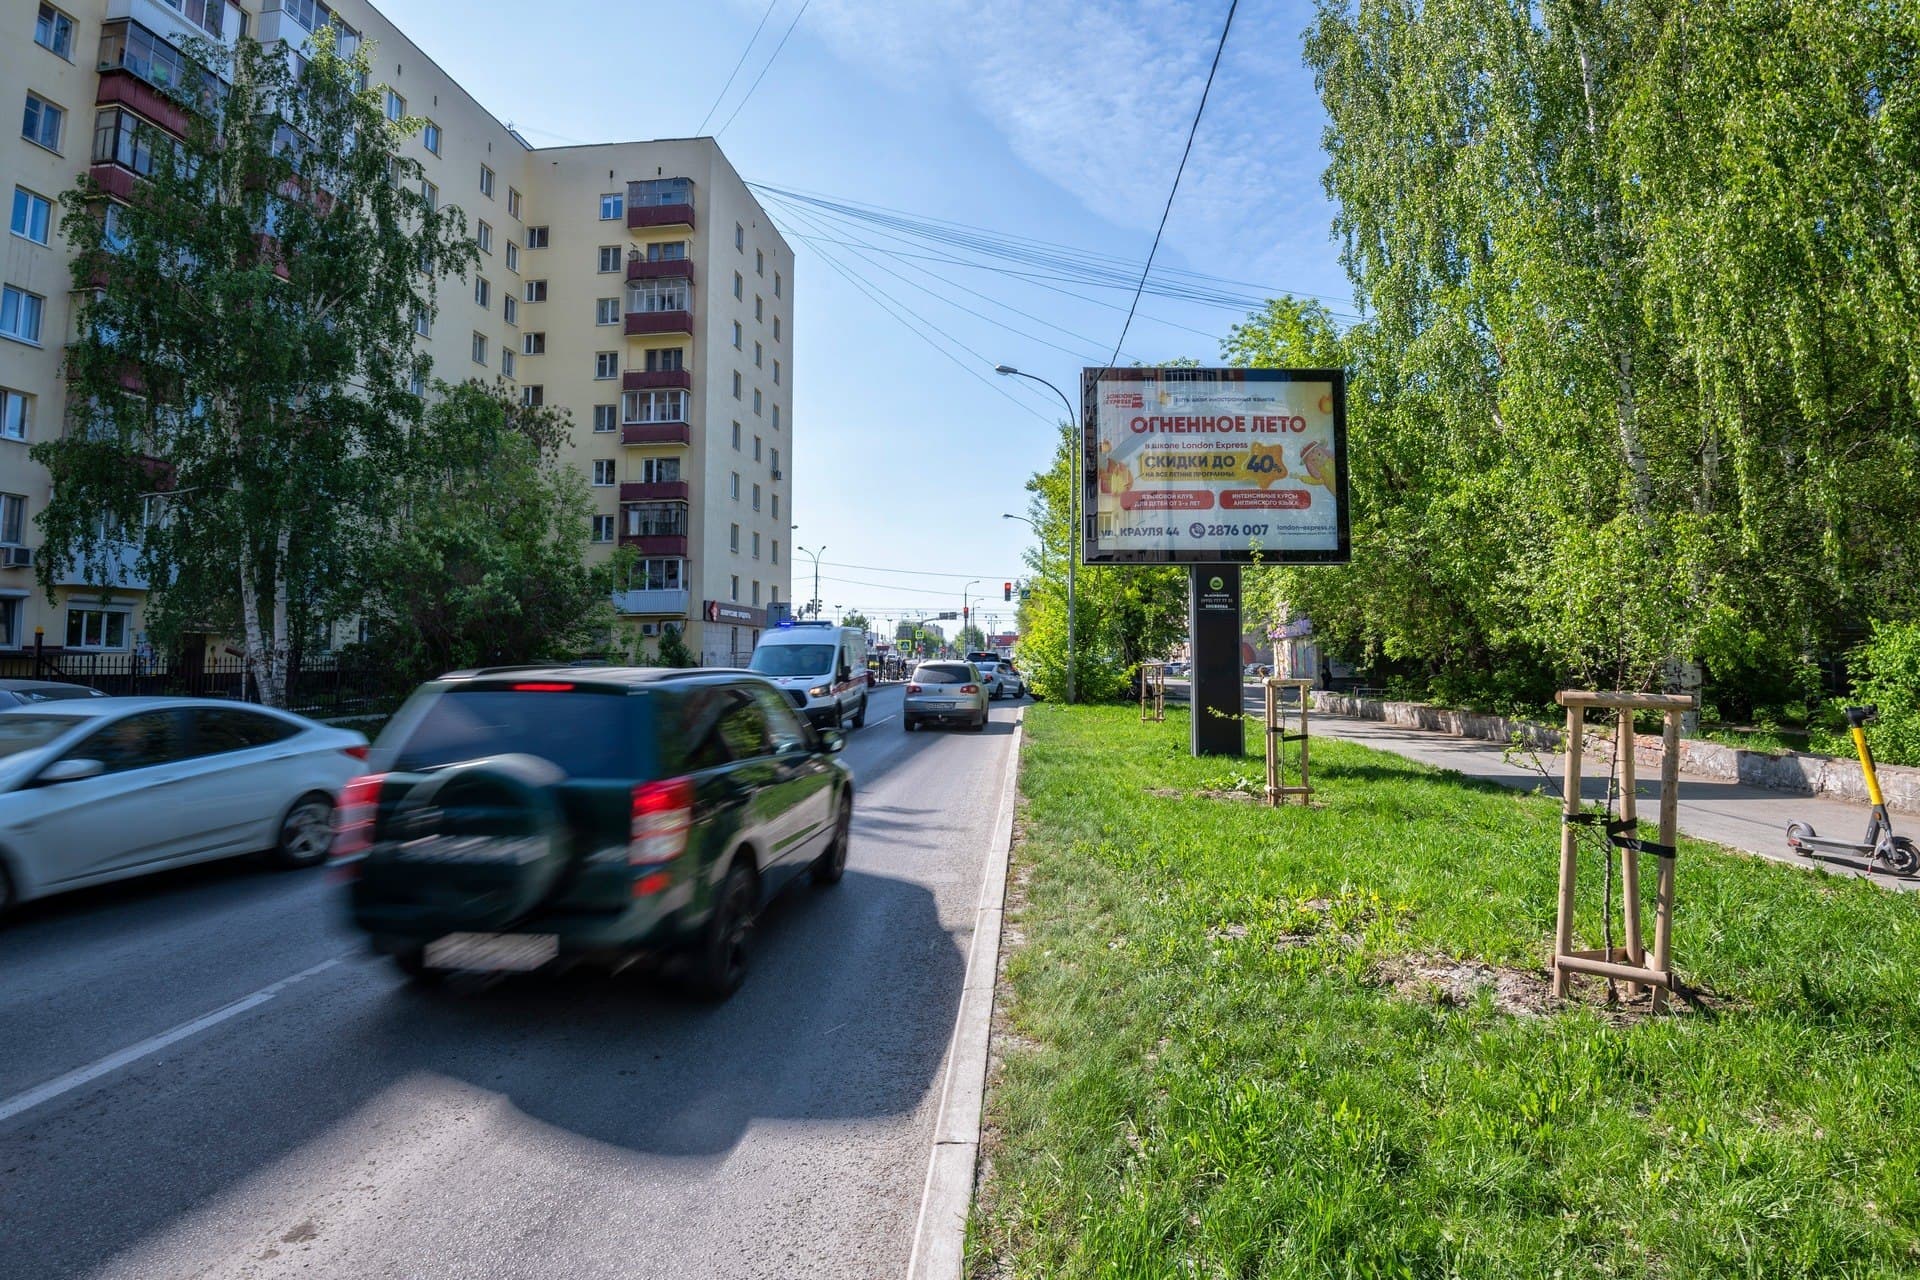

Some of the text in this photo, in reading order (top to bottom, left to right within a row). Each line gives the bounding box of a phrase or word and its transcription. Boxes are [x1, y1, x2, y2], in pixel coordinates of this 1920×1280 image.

[1130, 415, 1306, 433] ОГНЕННОЕ ЛЕТО
[1181, 441, 1214, 449] London
[1215, 441, 1249, 450] Express
[1145, 454, 1283, 473] СКИДКИ ДО 40%
[1120, 527, 1163, 537] КРАУЛЯ
[1165, 527, 1180, 537] 44
[1207, 525, 1240, 536] 2876
[1242, 524, 1269, 536] 007
[1277, 523, 1336, 532] london-express.ru
